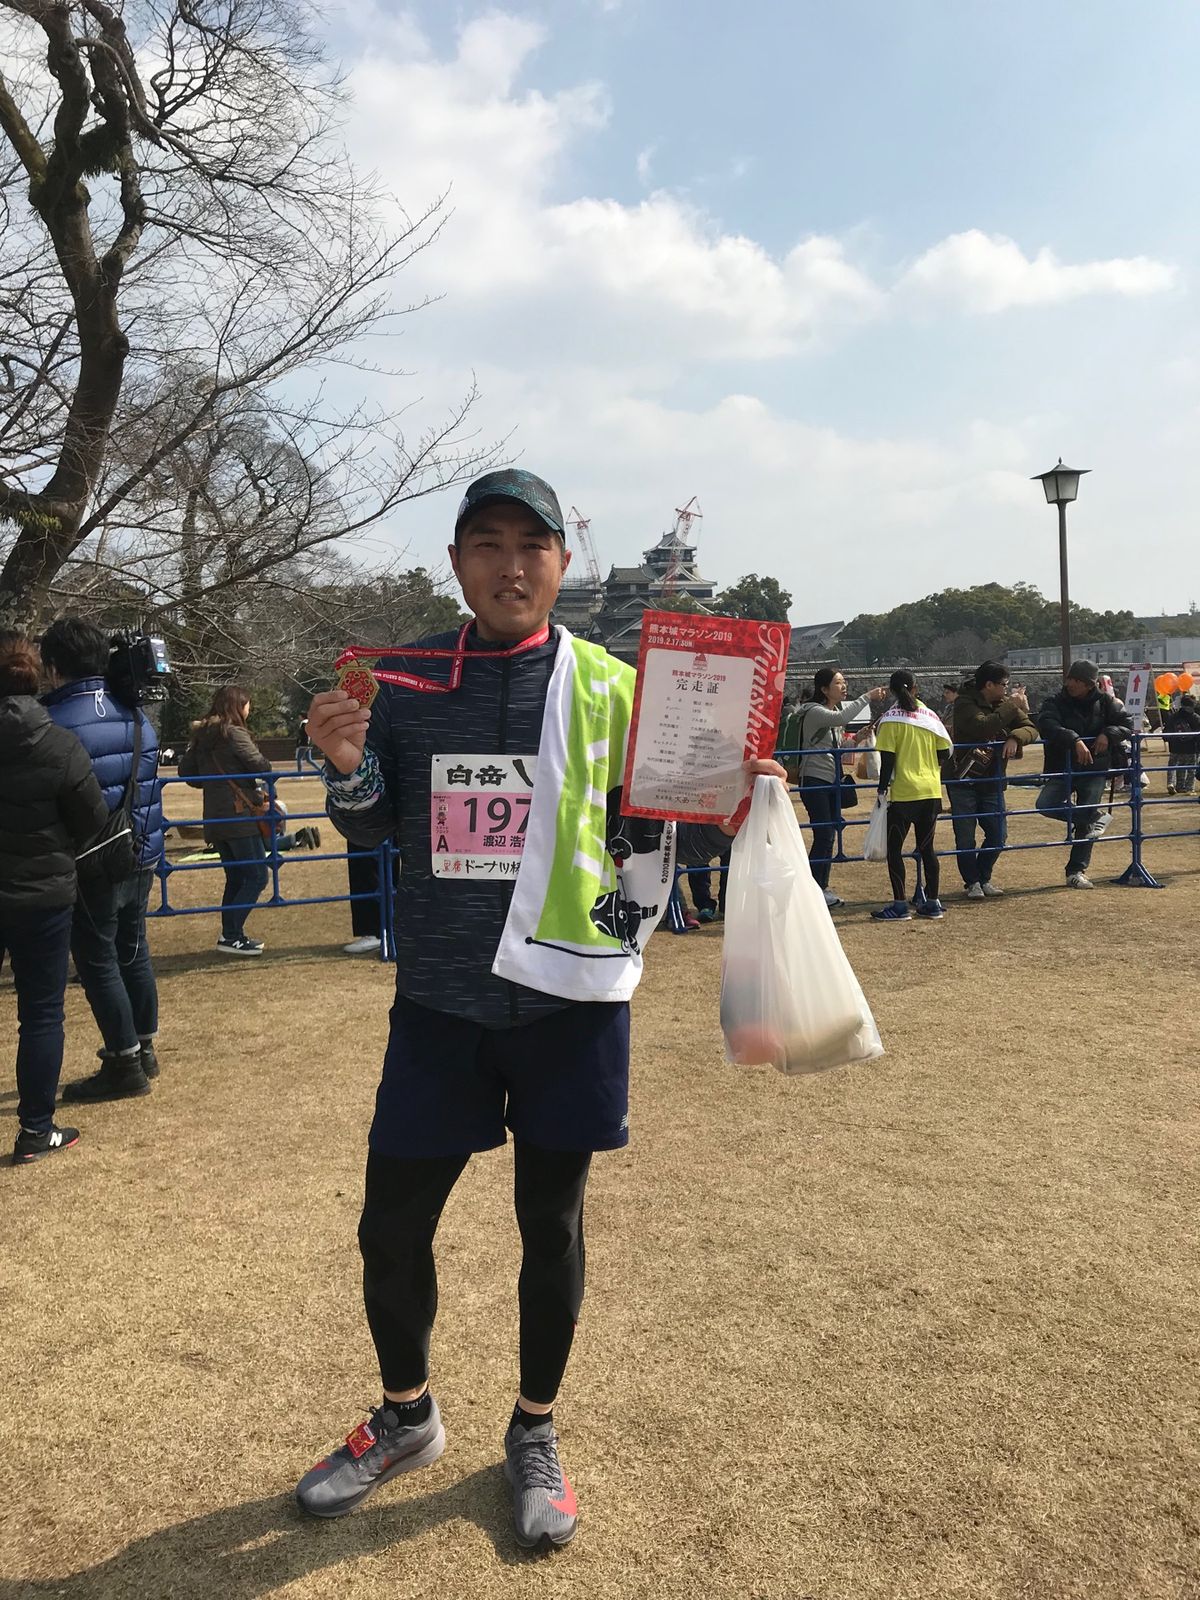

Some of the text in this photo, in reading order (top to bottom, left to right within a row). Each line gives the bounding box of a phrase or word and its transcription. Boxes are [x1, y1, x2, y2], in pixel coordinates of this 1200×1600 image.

[649, 623, 733, 642] 熊本城マラソン2019
[672, 669, 726, 682] 熊本城マラソン2019
[744, 624, 785, 760] Finisher
[436, 834, 449, 852] A
[483, 834, 506, 847] 渡辺
[49, 1132, 63, 1147] N
